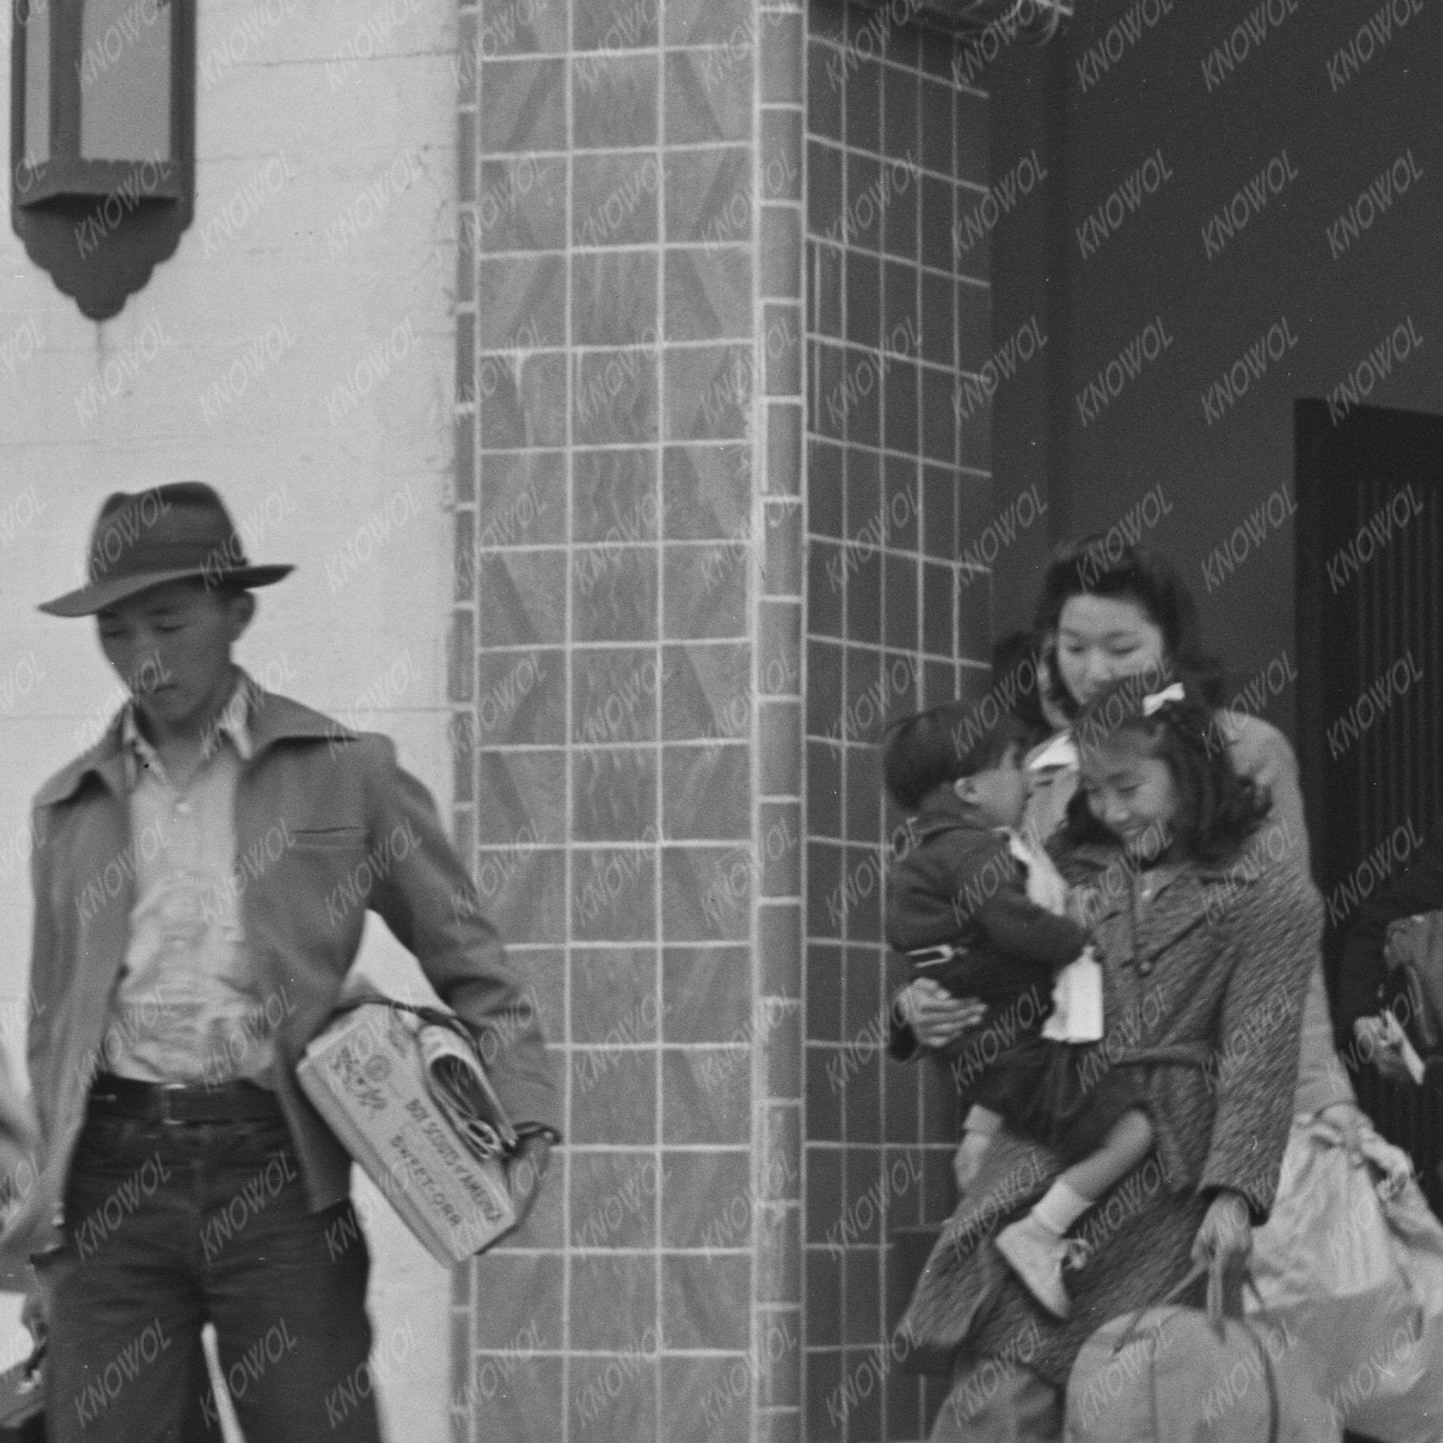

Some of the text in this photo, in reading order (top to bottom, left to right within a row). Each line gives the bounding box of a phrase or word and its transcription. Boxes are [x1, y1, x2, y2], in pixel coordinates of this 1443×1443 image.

[389, 1133, 461, 1227] SWEET-ORR
[422, 1121, 462, 1166] SCOUTS
[458, 1172, 505, 1226] AMERICA
